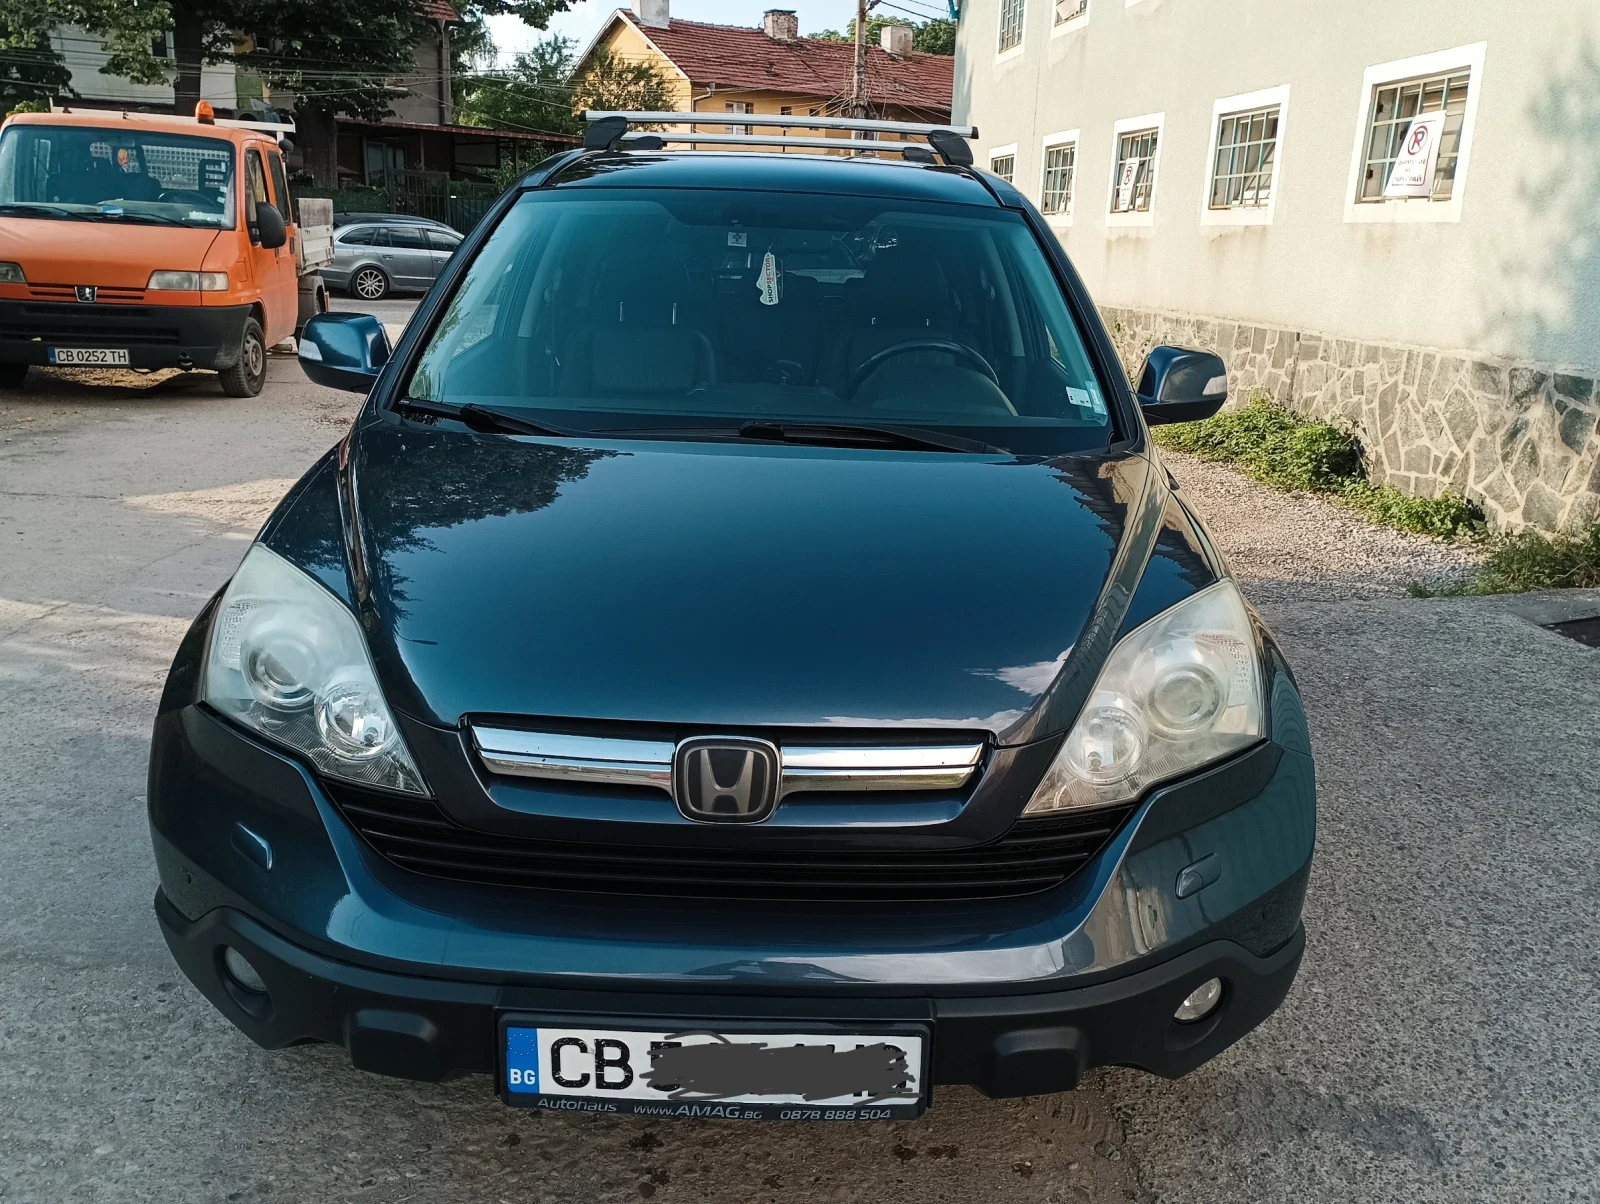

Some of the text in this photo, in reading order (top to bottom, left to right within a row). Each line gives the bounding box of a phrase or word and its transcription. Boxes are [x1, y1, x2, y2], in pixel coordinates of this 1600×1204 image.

[765, 257, 774, 303] SHOPSECTOR
[57, 350, 127, 363] CB 0252 TH
[550, 1036, 634, 1091] CB
[510, 1068, 536, 1085] BG
[538, 1098, 618, 1112] Autohaus
[780, 1109, 821, 1120] 0878
[824, 1109, 857, 1120] 888
[859, 1109, 892, 1120] 504
